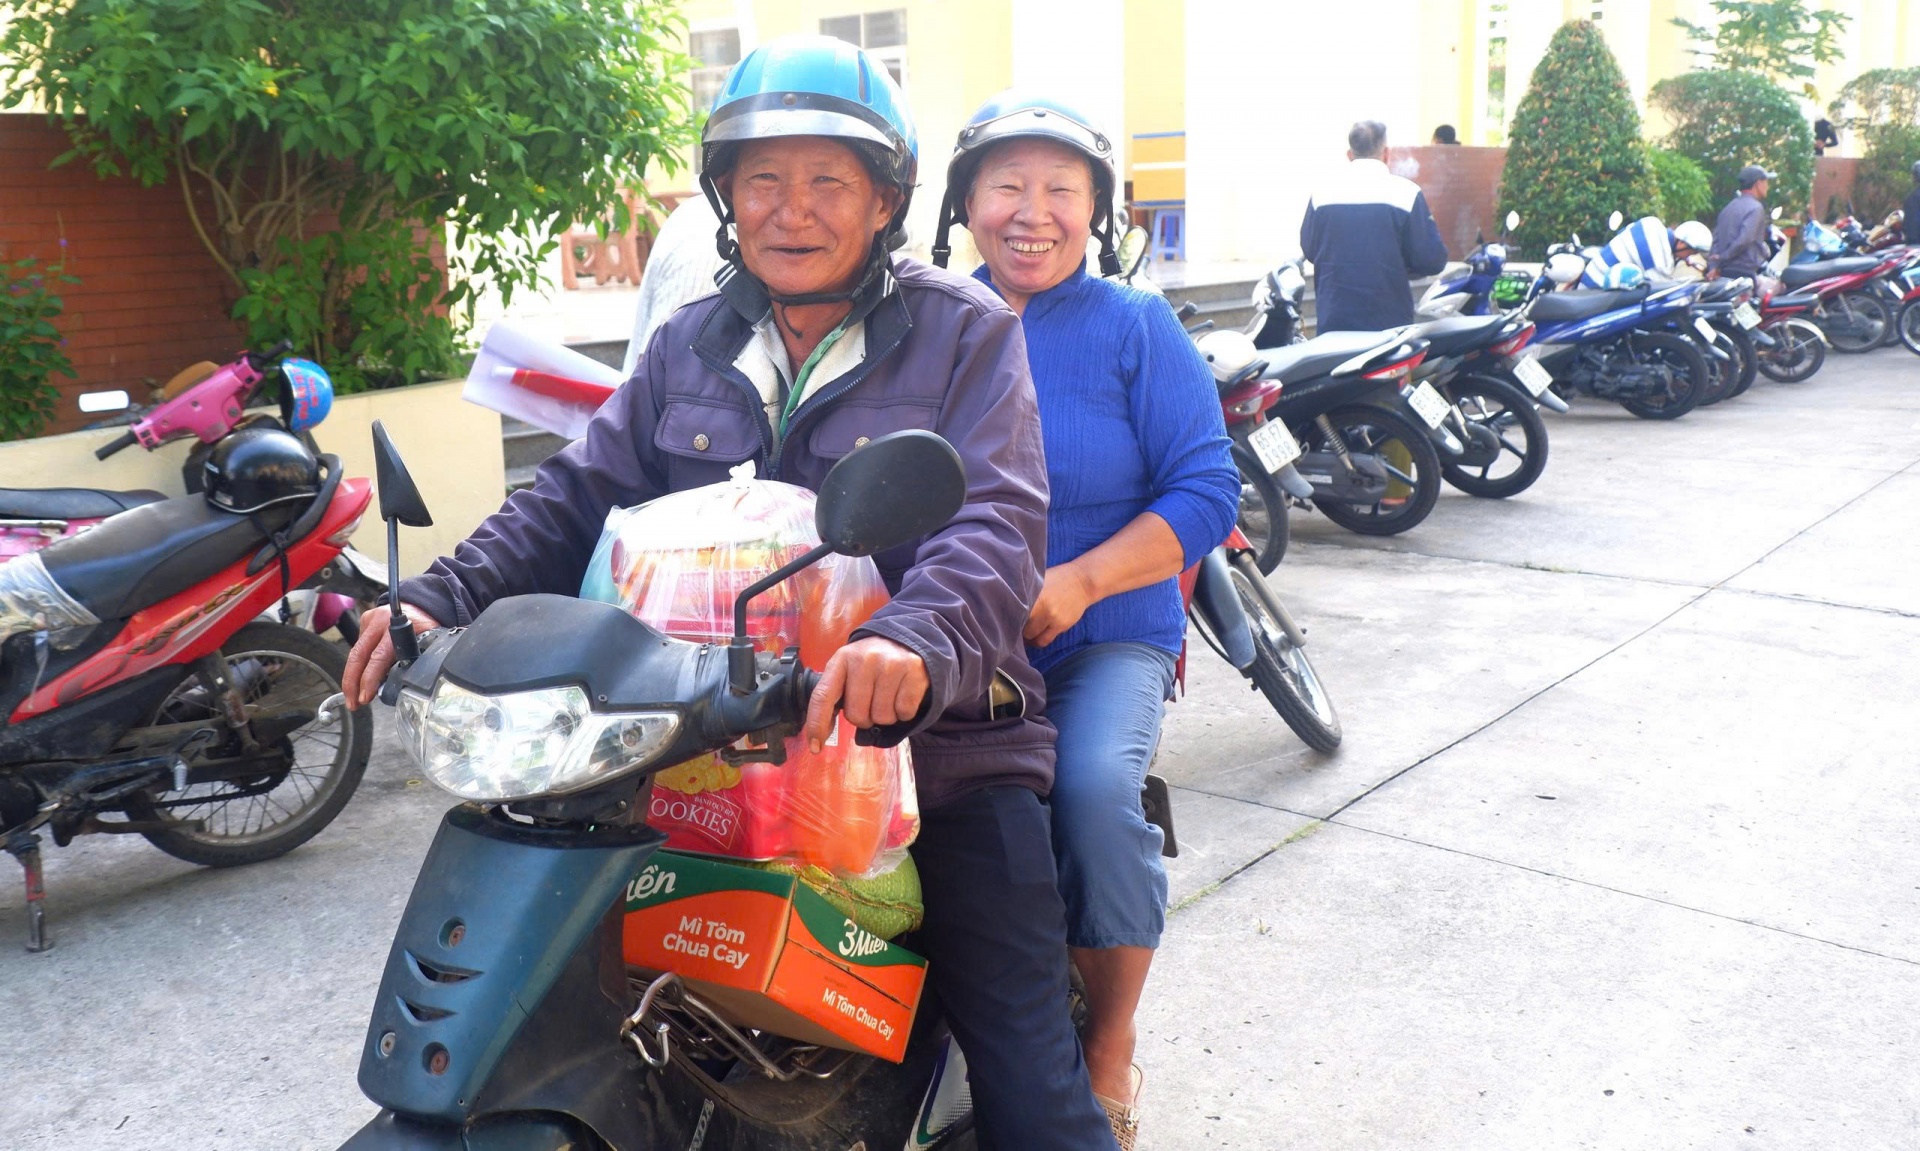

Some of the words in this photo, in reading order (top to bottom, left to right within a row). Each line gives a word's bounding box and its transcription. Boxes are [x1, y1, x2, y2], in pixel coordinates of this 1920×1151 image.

[1265, 440, 1294, 467] 1998
[651, 794, 732, 836] OOKIES
[679, 915, 703, 936] Mì
[706, 920, 746, 945] Tôm
[662, 933, 710, 958] Chua
[713, 944, 750, 970] Cay
[822, 987, 837, 1006] Mì
[836, 994, 856, 1018] Tôm
[855, 1006, 878, 1030] Chua
[878, 1019, 895, 1041] Cay
